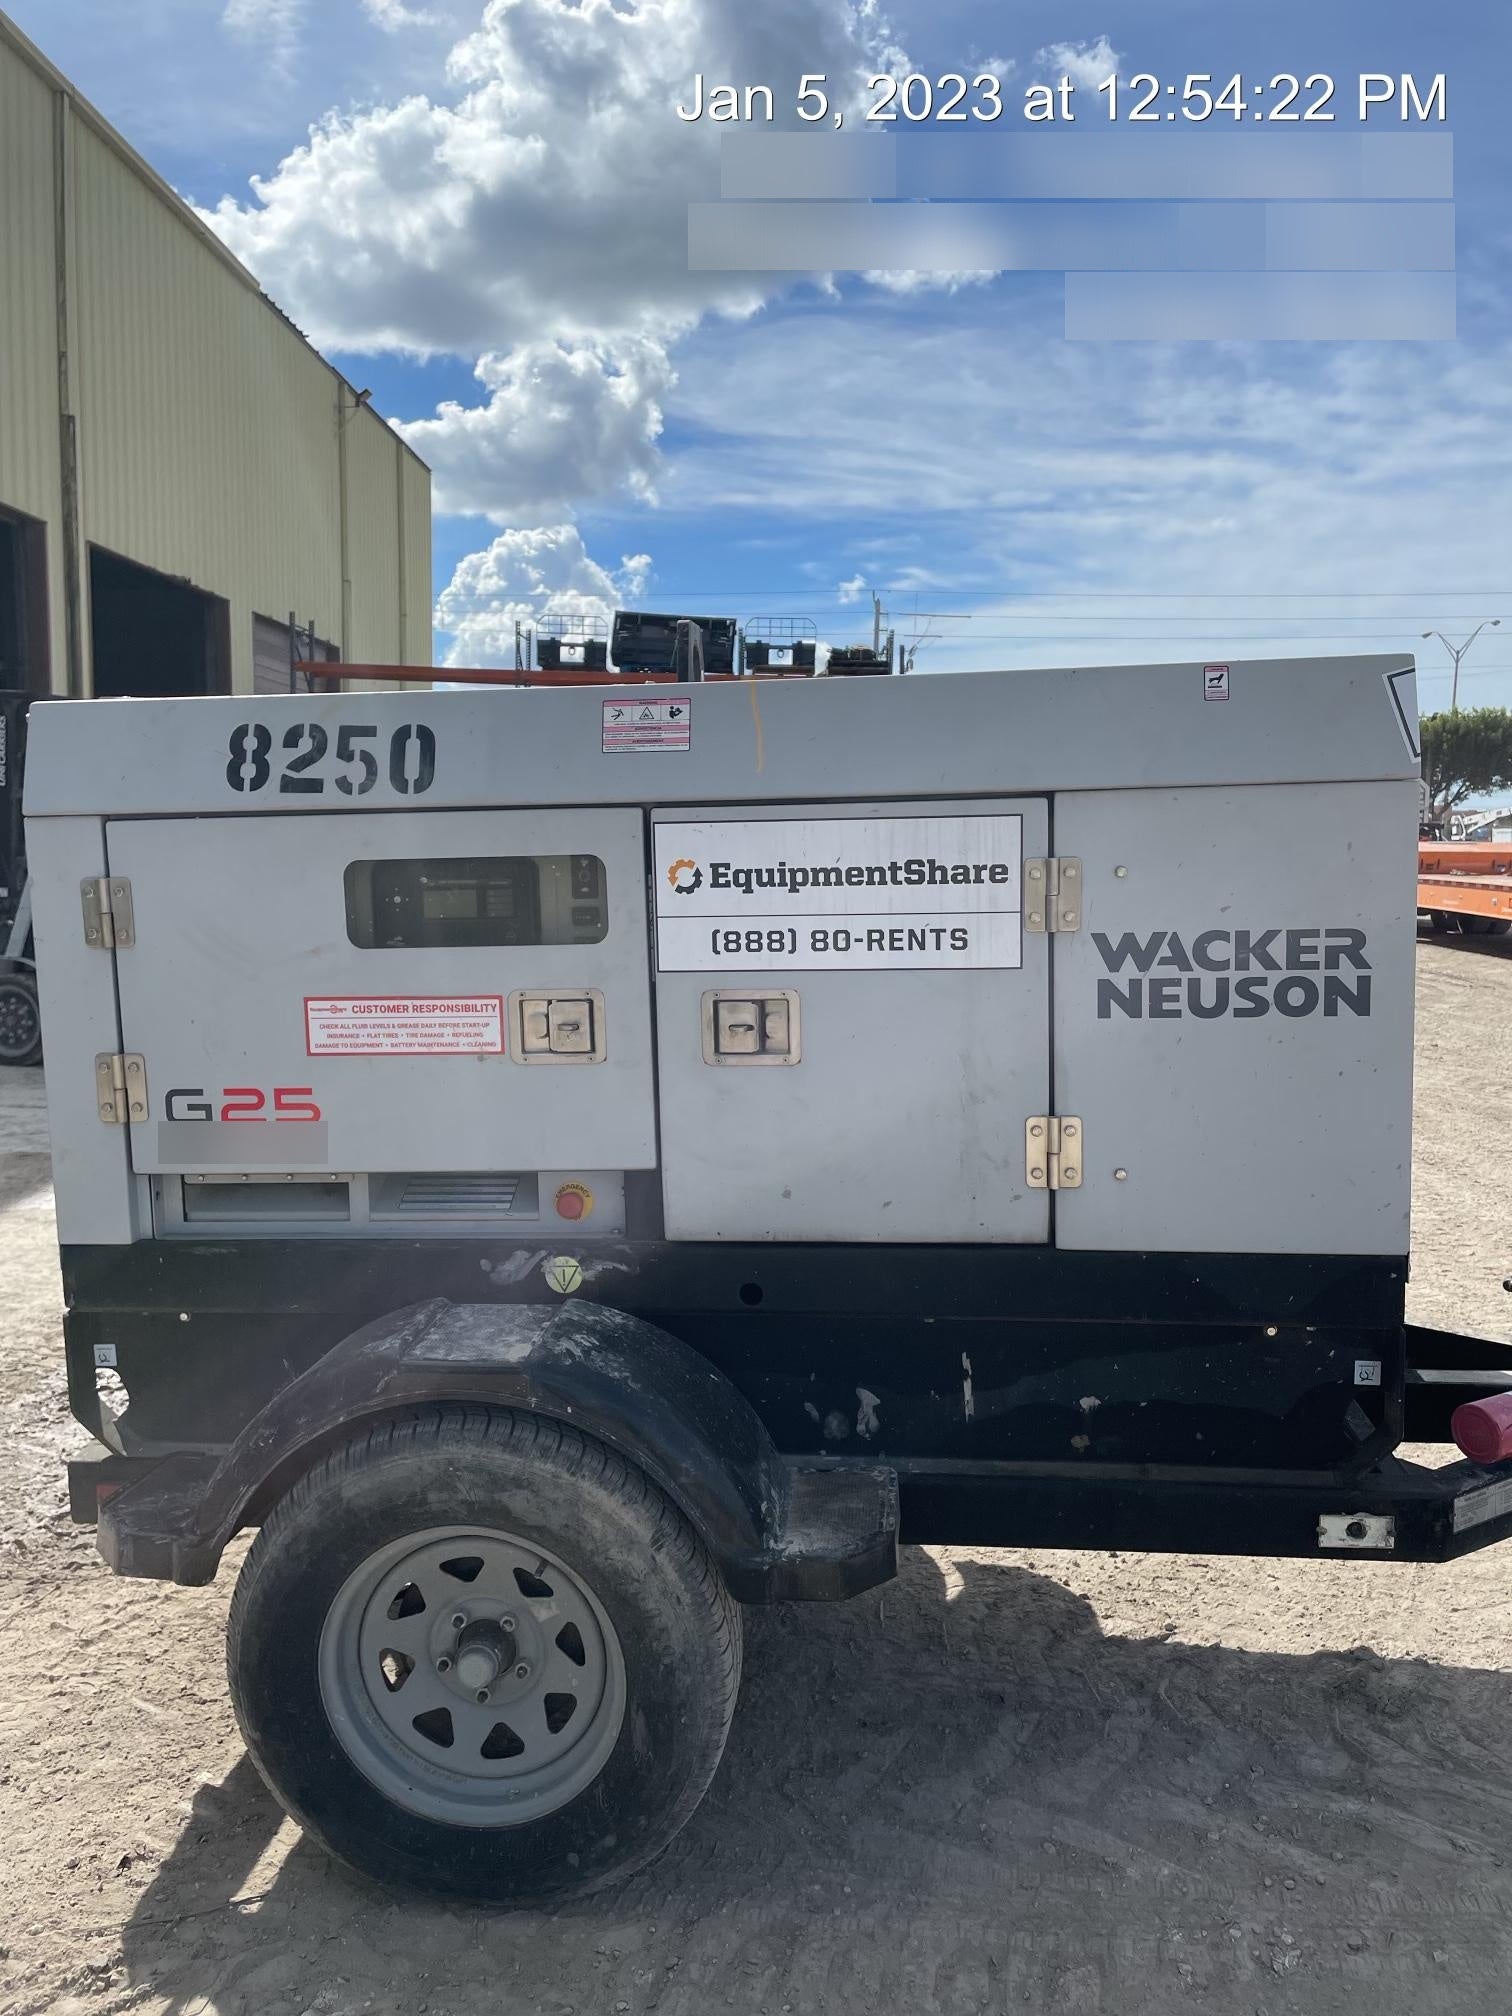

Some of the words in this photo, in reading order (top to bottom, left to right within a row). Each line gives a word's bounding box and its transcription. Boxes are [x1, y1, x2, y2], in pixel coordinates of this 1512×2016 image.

[226, 723, 436, 795] 8250
[709, 859, 1009, 894] EquipmentShare
[711, 929, 797, 954] (888)
[810, 928, 969, 952] 80-RENTS
[1090, 928, 1373, 973] WACKER
[351, 1004, 409, 1014] CUSTOMER
[412, 1003, 497, 1013] RESPONSIBILITY
[1097, 975, 1371, 1019] NEUSON
[165, 1087, 321, 1122] G25
